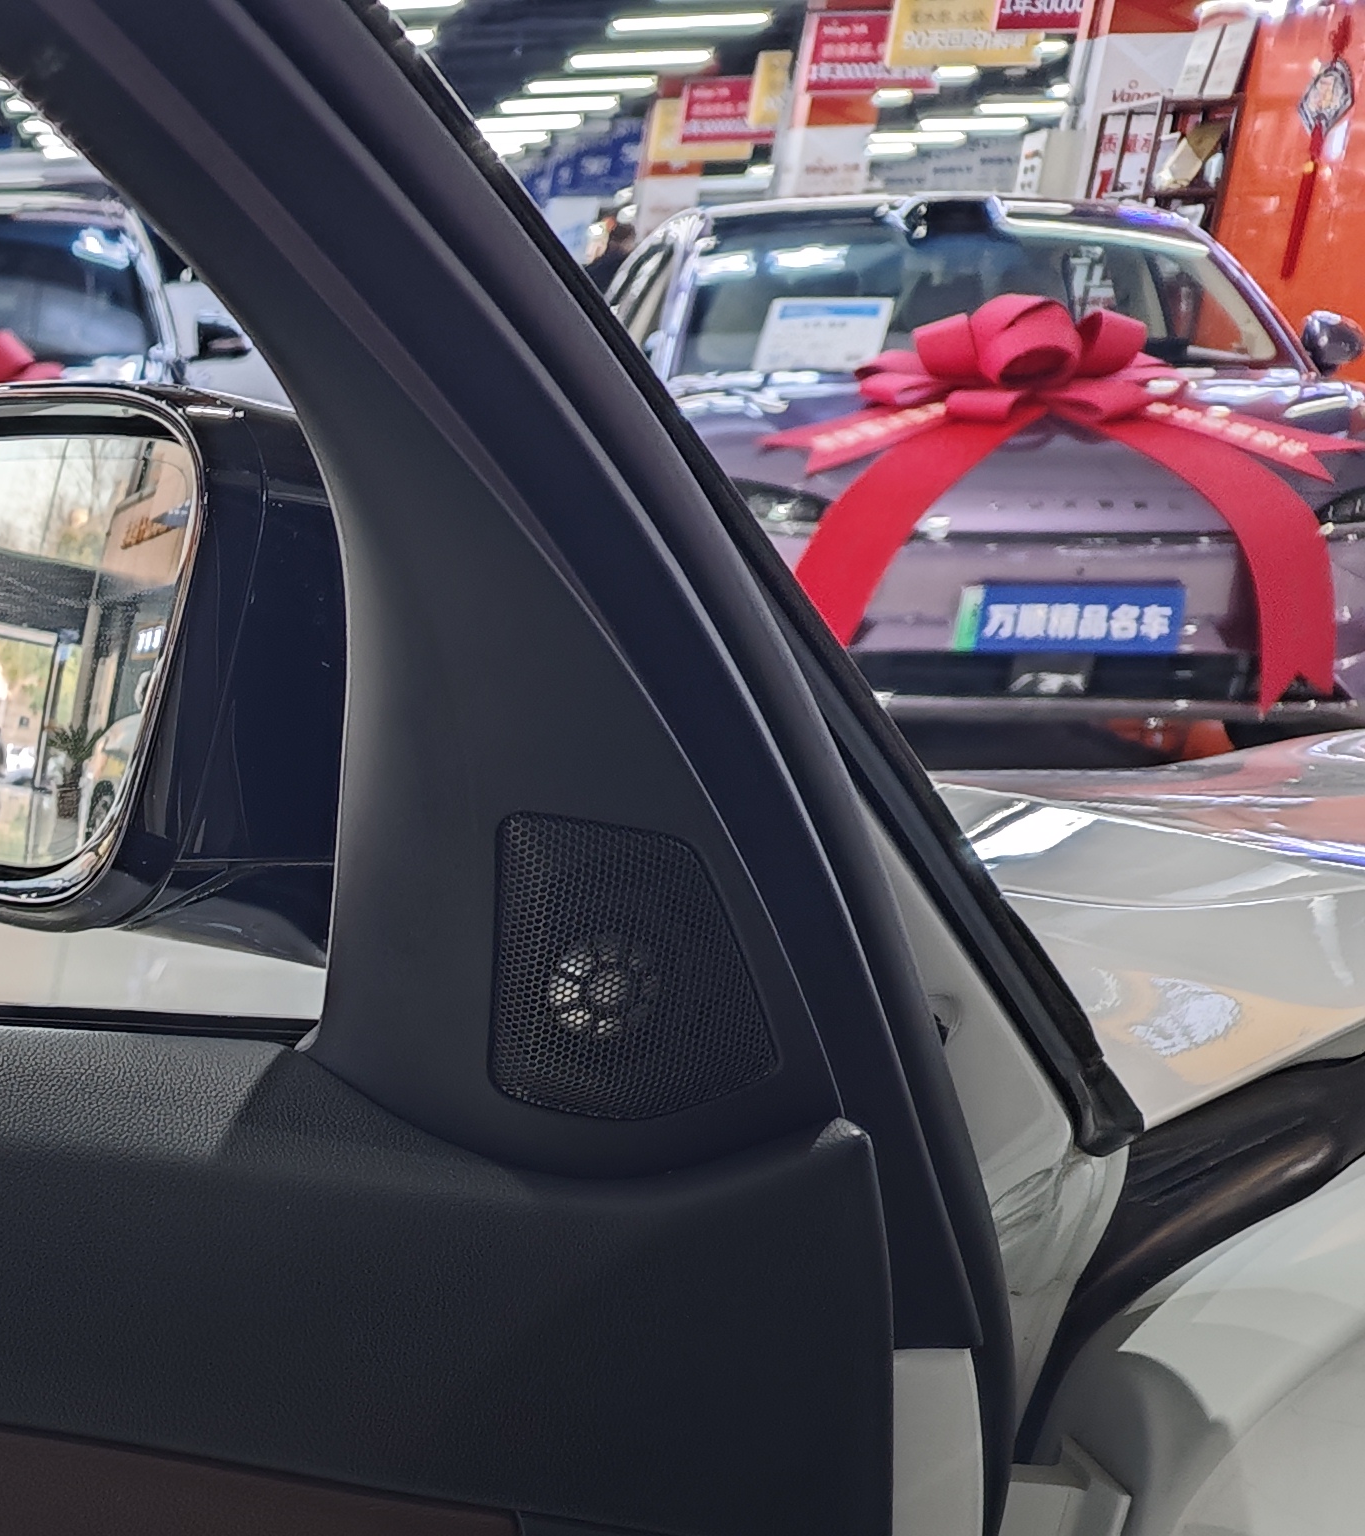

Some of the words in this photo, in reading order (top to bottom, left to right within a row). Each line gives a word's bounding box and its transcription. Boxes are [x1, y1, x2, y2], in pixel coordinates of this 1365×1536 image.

[983, 603, 1172, 641] 万顺精品名车
